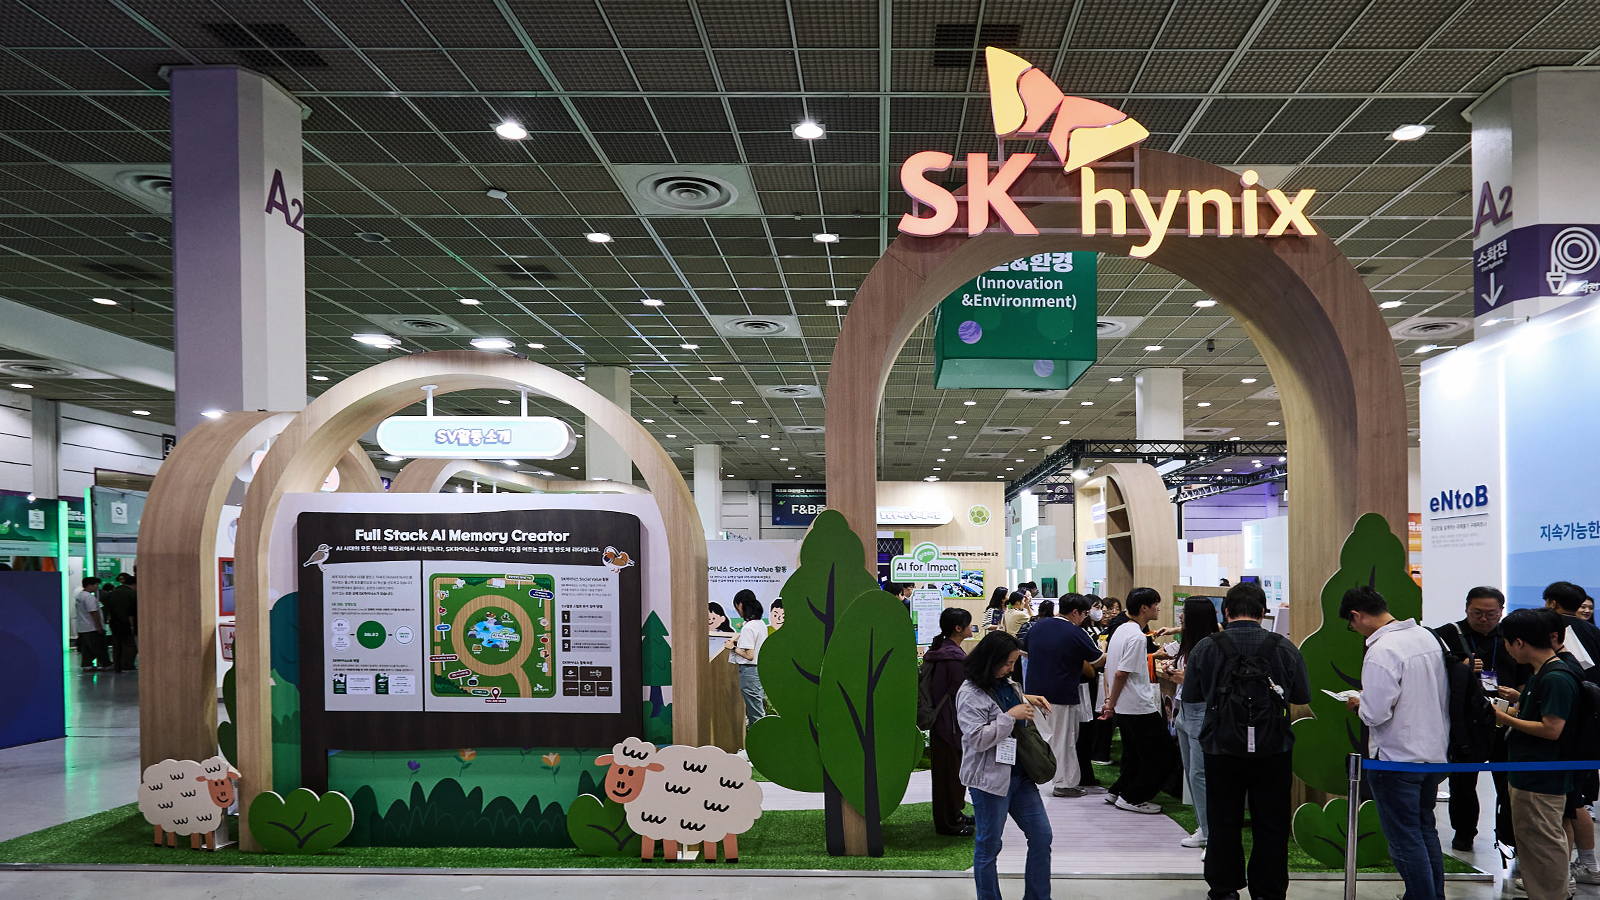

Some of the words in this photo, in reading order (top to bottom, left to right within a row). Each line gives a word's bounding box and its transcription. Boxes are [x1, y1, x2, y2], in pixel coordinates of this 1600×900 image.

[265, 168, 305, 234] A2
[898, 150, 1040, 237] SK
[1080, 166, 1318, 259] hynix
[1473, 180, 1513, 238] A2
[990, 251, 1074, 273] &환경
[1477, 239, 1508, 267] 소화전
[976, 275, 1063, 292] (Innovation
[961, 293, 1078, 311] &Environment)
[435, 428, 484, 446] SV활동
[485, 428, 512, 444] 소개
[1429, 484, 1489, 513] eNtoB
[355, 528, 381, 541] Full
[383, 529, 428, 541] Stack
[430, 529, 446, 541] AI
[448, 529, 509, 544] Memory
[511, 530, 570, 542] Creator
[1540, 520, 1600, 542] 지속가능한
[896, 562, 907, 571] AI
[909, 562, 923, 571] for
[927, 563, 957, 573] Impact
